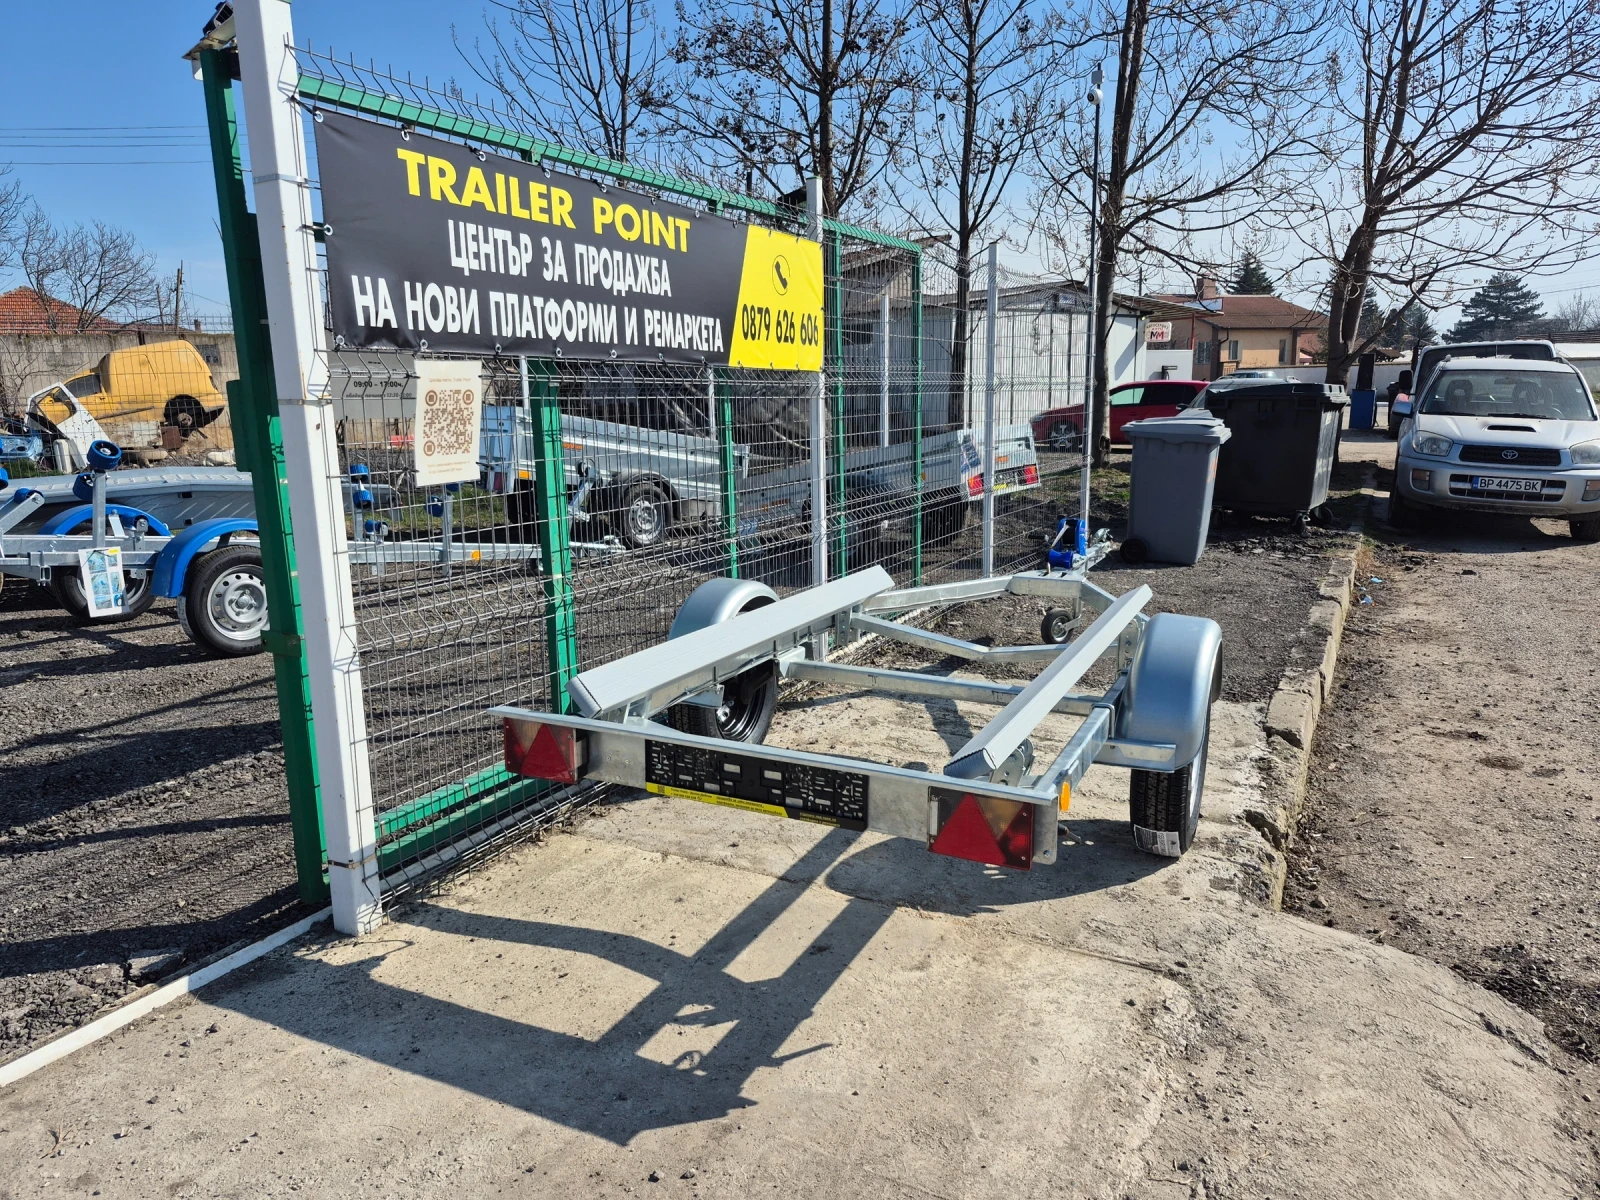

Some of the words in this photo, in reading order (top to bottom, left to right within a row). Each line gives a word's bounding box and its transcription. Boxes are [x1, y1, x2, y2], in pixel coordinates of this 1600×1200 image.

[397, 148, 576, 229] TRAILER
[593, 197, 691, 253] POINT
[448, 219, 533, 277] ЦЕНТЪР
[542, 239, 568, 283] ЗА
[574, 243, 672, 297] ПРОДАЖБА
[351, 274, 398, 329] НА
[404, 281, 481, 335] НОВИ
[488, 291, 618, 344] ПЛАТФОРМИ
[624, 306, 638, 346] И
[644, 308, 724, 353] РЕМАРКЕТА
[741, 303, 771, 341] 0879
[775, 310, 795, 343] 626
[800, 314, 819, 347] 606
[1480, 479, 1494, 488] BP
[1496, 480, 1522, 490] 4475
[1524, 481, 1539, 491] BK
